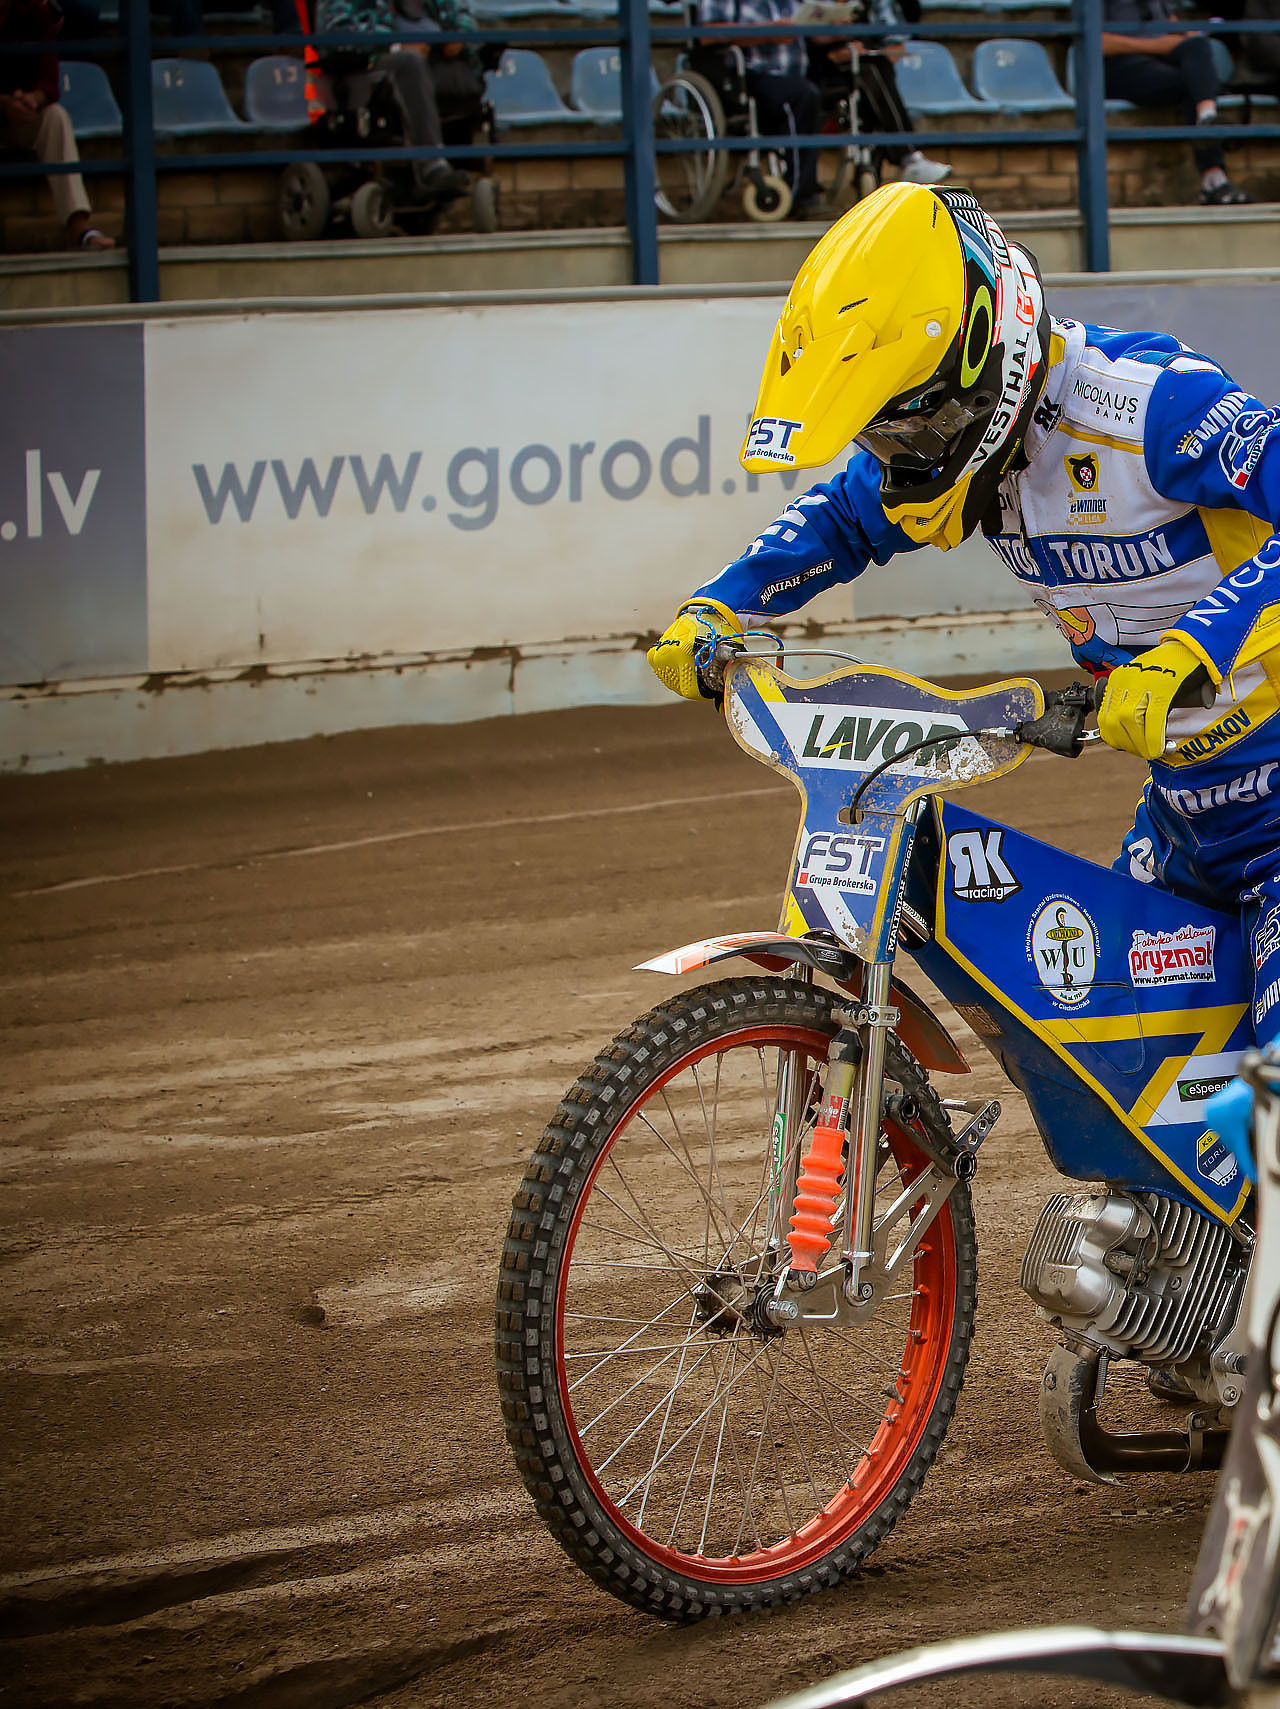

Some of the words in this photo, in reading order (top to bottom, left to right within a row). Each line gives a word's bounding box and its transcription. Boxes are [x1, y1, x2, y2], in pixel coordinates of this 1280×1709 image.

[969, 332, 1030, 464] VESTHAL
[1072, 379, 1139, 413] NICOLAUS
[1096, 406, 1136, 424] BANK
[747, 417, 802, 449] FST
[756, 448, 794, 462] Brokerska
[192, 414, 800, 532] www.gorod.
[1048, 533, 1176, 586] TORUŃ
[802, 714, 959, 768] LAVOR
[802, 835, 882, 875] FST
[809, 874, 832, 887] Grupa
[832, 876, 874, 891] Brokerska
[969, 886, 1004, 900] racing
[1131, 941, 1213, 976] pryzmat
[1202, 1144, 1226, 1169] TORU
